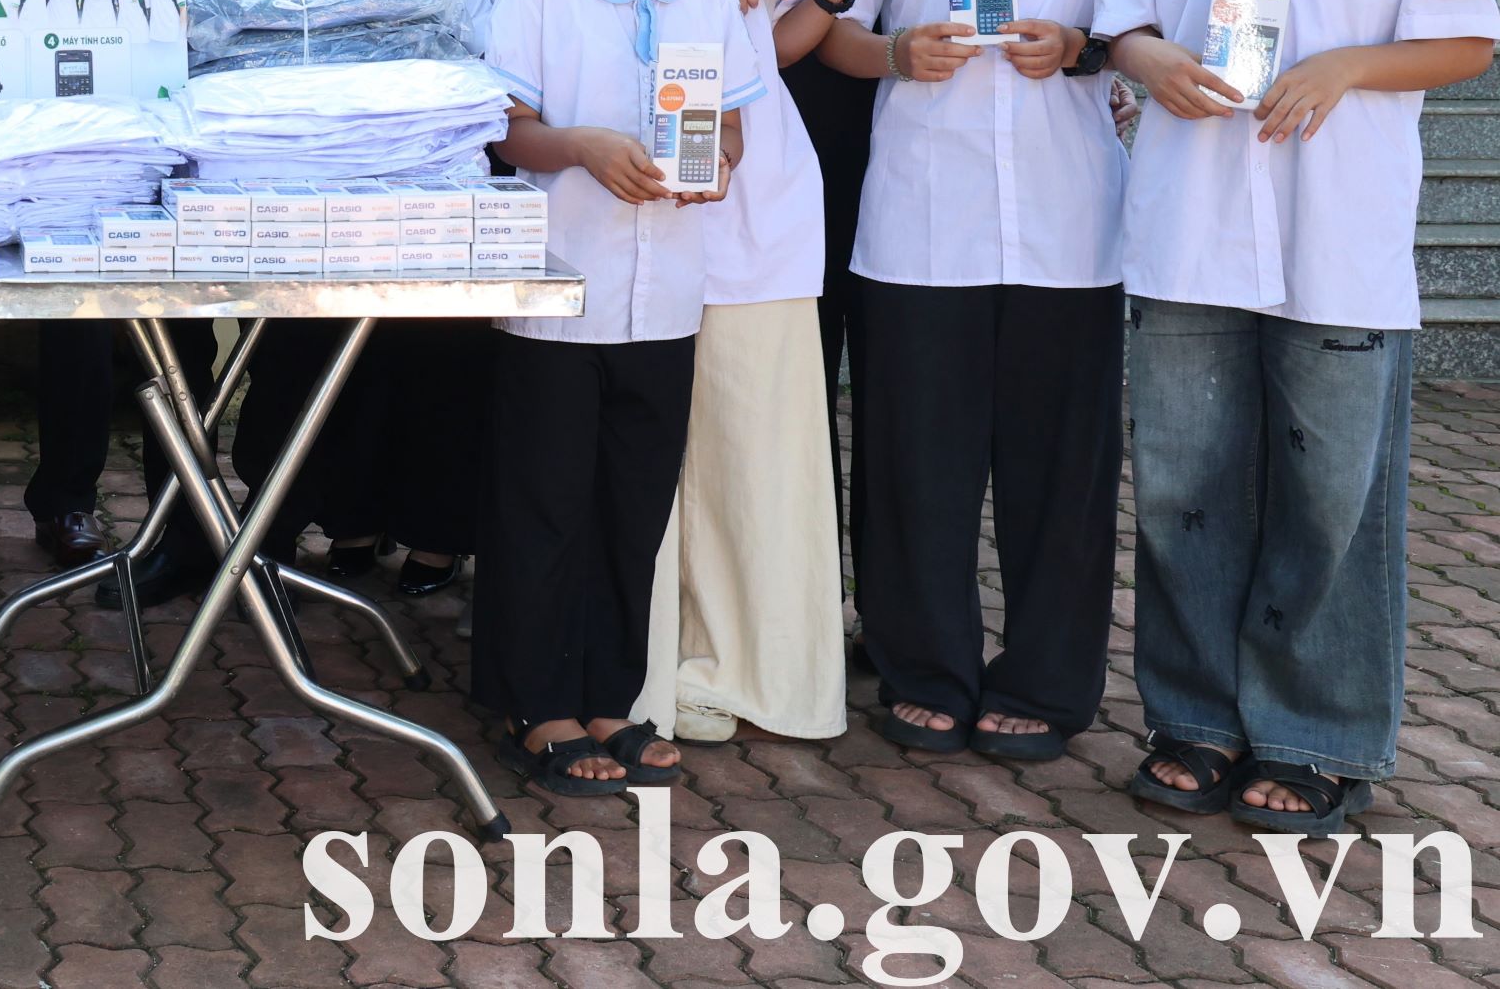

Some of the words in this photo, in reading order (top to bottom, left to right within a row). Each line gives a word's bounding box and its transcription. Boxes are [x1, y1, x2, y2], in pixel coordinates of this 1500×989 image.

[47, 36, 56, 46] 4
[62, 36, 78, 45] MÁY
[100, 36, 123, 45] CASIO
[663, 69, 717, 80] CASIO
[108, 231, 141, 239] CASIO
[105, 255, 137, 263] CASIO
